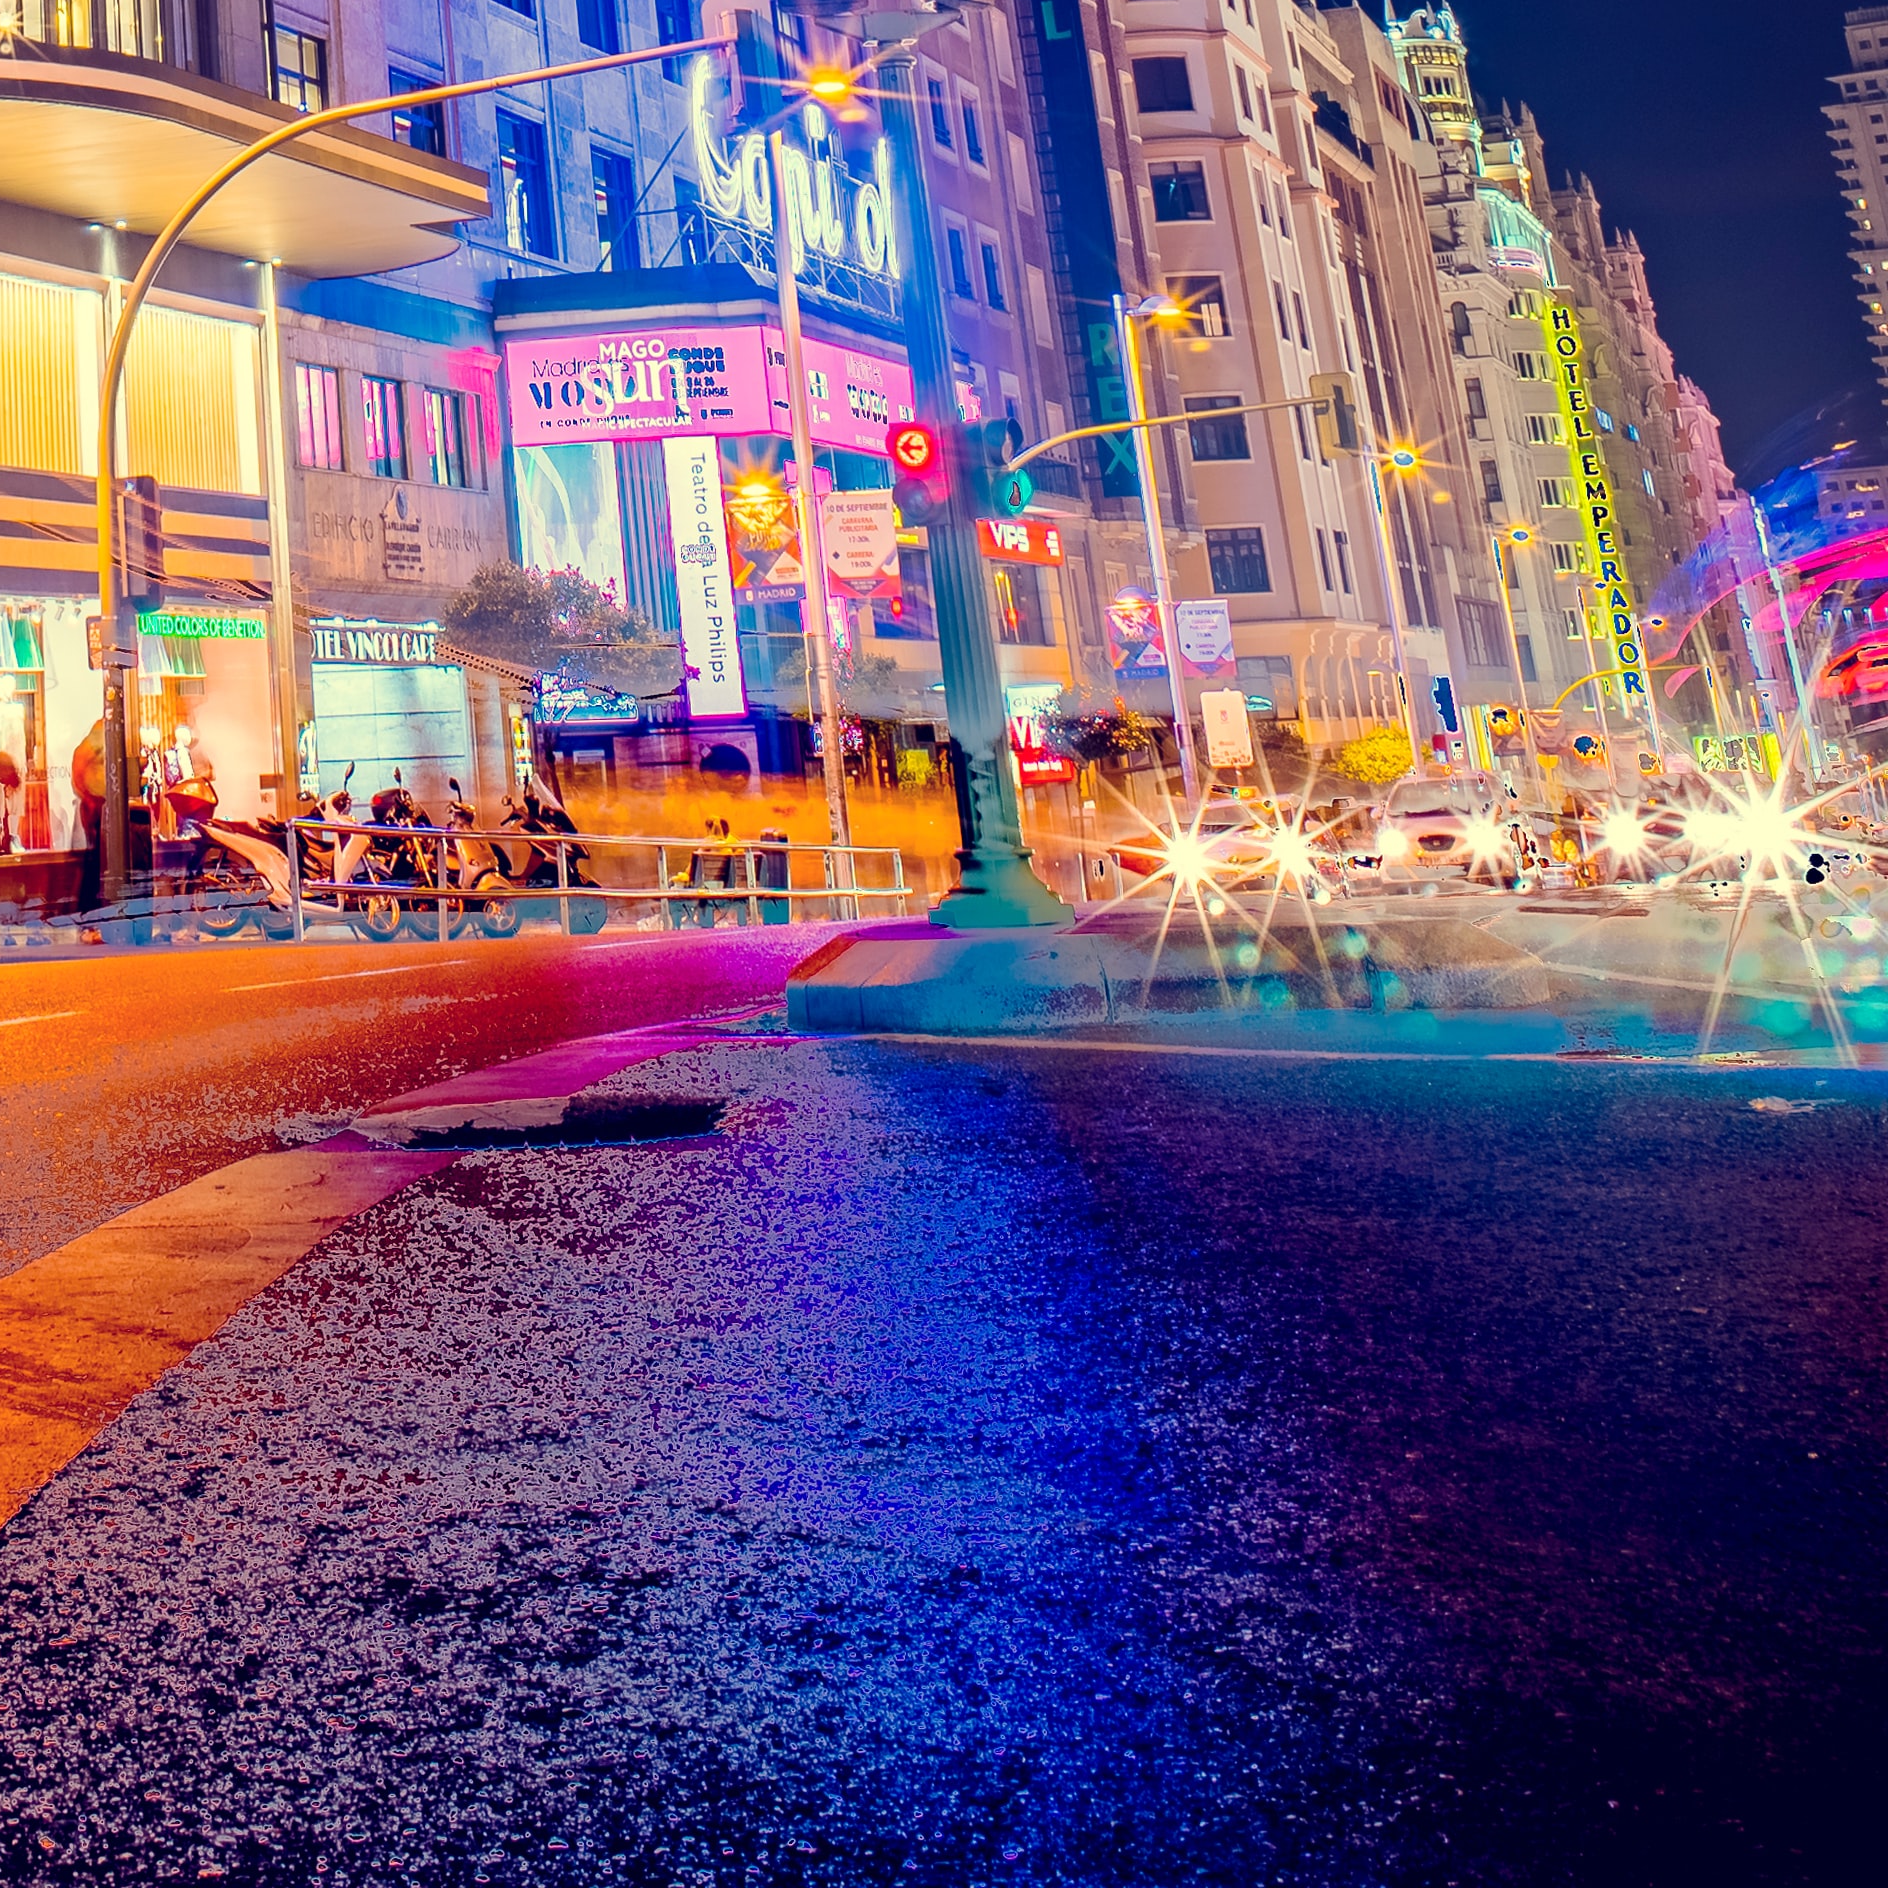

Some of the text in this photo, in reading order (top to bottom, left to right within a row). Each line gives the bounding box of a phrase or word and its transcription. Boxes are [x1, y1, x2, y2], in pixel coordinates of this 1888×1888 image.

[598, 338, 665, 361] MAGO
[532, 355, 600, 378] Madrid
[1088, 322, 1137, 477] REX
[688, 452, 708, 516] Teatro
[826, 505, 835, 513] 10
[1550, 308, 1646, 695] HOTEL EMPERADOR
[697, 520, 714, 545] de
[989, 521, 1030, 553] VIPS
[701, 575, 718, 609] Luz
[758, 587, 796, 599] MADRID
[140, 614, 266, 639] UNITED COLORS OF BENETTON
[346, 630, 399, 661] VINCCI
[707, 616, 726, 683] Philips
